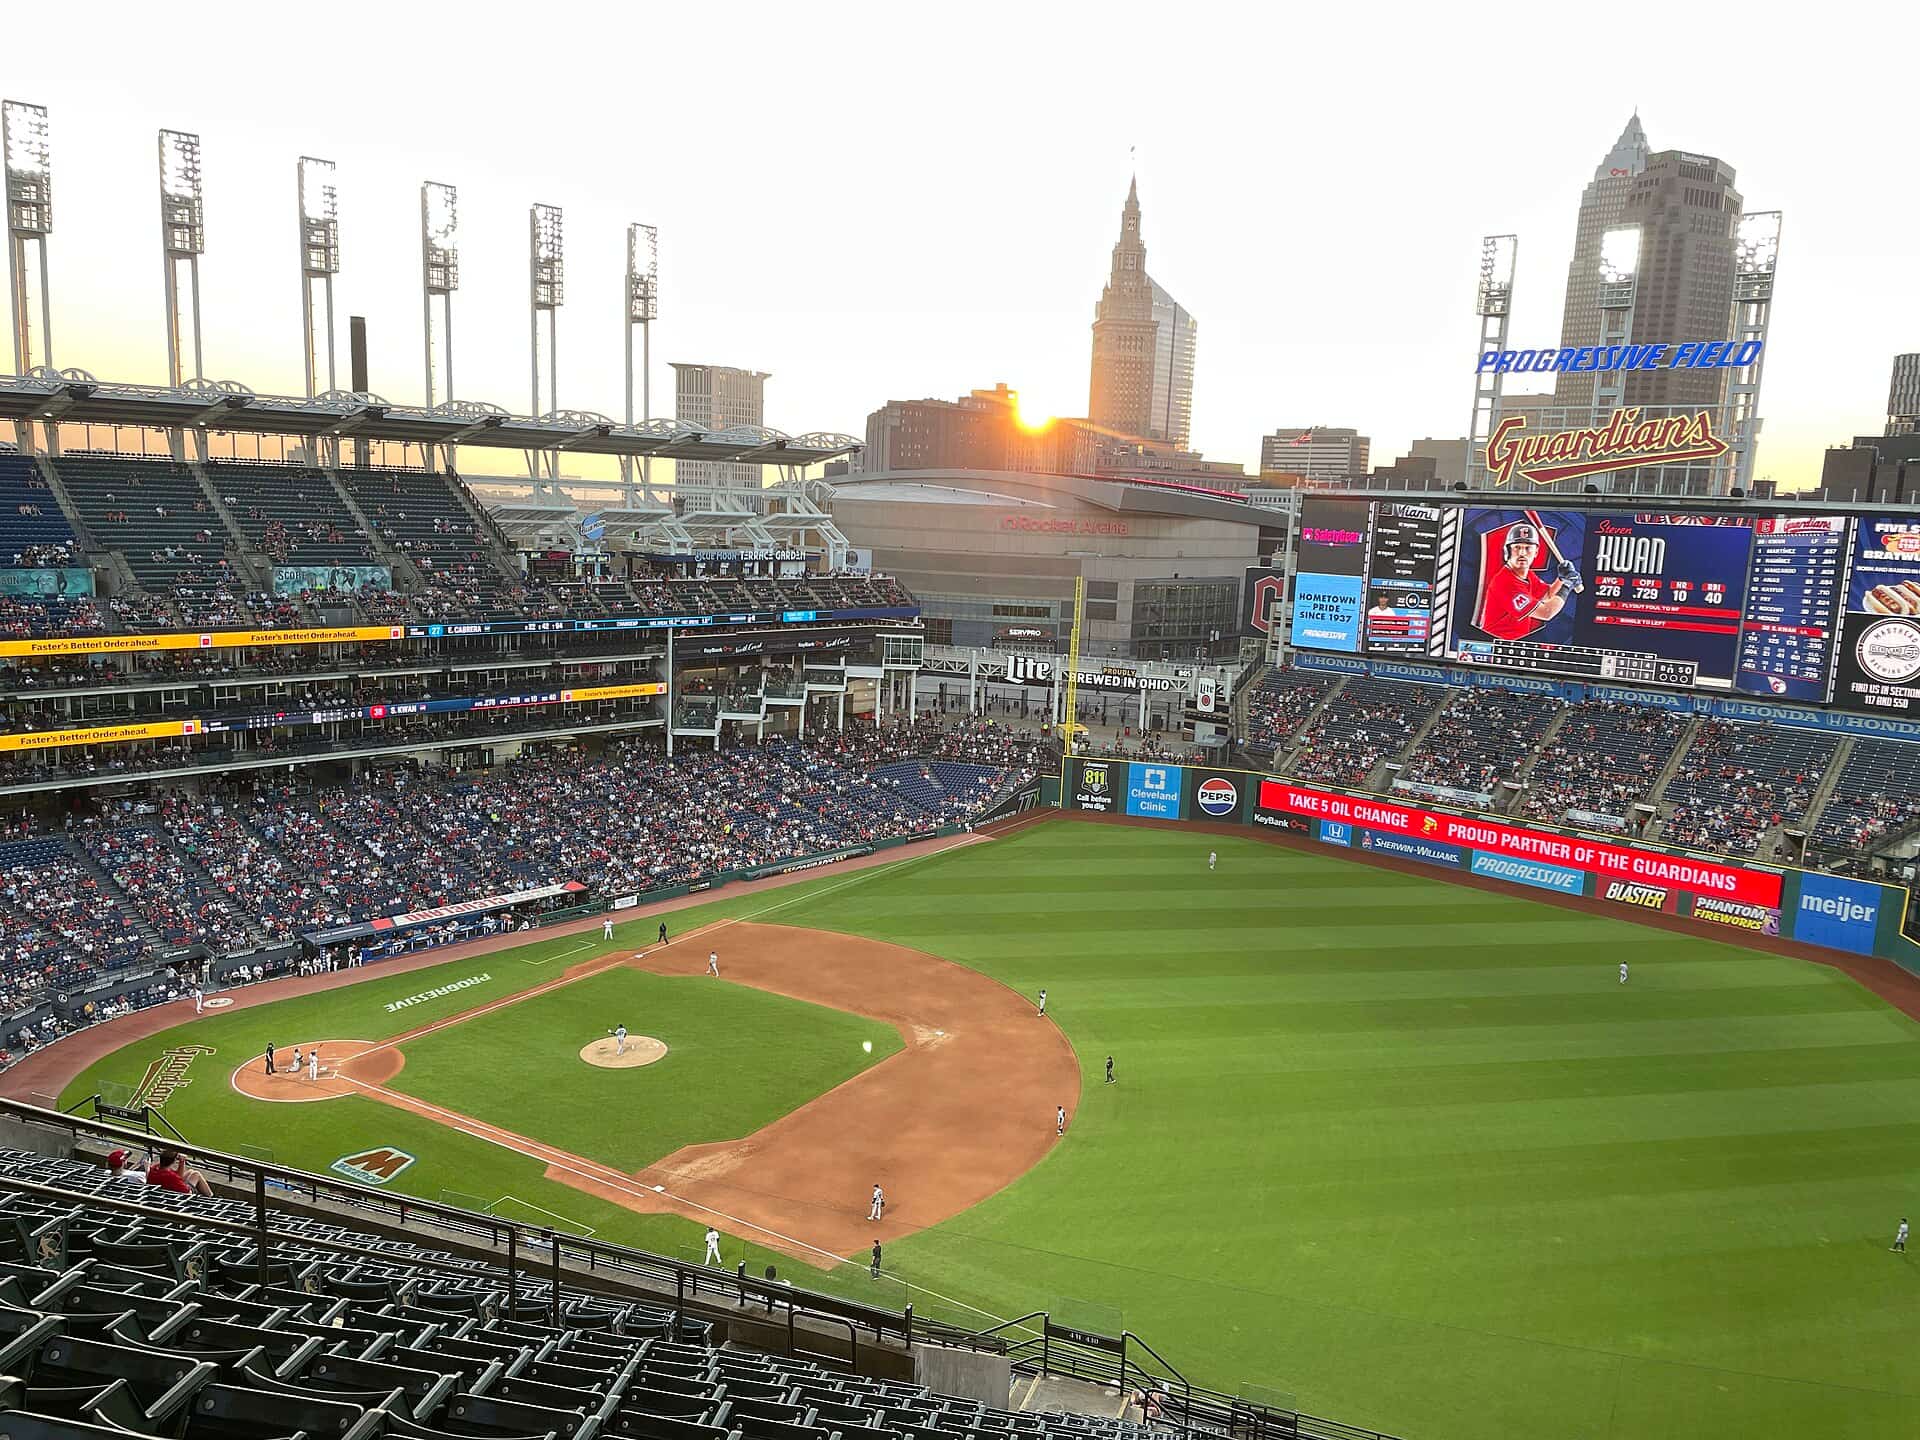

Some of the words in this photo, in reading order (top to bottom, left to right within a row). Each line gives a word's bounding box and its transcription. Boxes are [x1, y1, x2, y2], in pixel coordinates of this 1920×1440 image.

[1476, 345, 1668, 374] PROGRESSIVE
[1670, 341, 1762, 369] FIELD
[1486, 407, 1729, 486] Guardians
[1020, 516, 1076, 533] Rocket
[1082, 519, 1128, 536] Arena
[1595, 520, 1632, 535] Steven
[1784, 517, 1832, 534] Guardians
[716, 551, 736, 560] MOON
[740, 551, 773, 560] TERRACE
[776, 551, 806, 560] GARDEN
[1596, 536, 1666, 574] KWAN
[1602, 577, 1617, 585] AVG
[1639, 579, 1655, 587] OPS
[1677, 581, 1688, 589] HR
[1706, 583, 1721, 591] RBI
[1299, 592, 1356, 604] HOMETOWN
[1595, 586, 1621, 597] .276
[1632, 588, 1658, 600] .729
[1673, 590, 1687, 602] 10
[1705, 592, 1722, 604] 40
[1251, 575, 1284, 632] C
[1312, 604, 1340, 612] PRIDE
[1300, 611, 1326, 620] SINCE
[1329, 614, 1352, 623] 1937
[251, 634, 282, 642] Faster's
[310, 632, 332, 640] Order
[332, 631, 357, 639] ahead.
[430, 627, 441, 635] 27
[453, 625, 482, 633] CABRERA
[1009, 628, 1041, 637] SERVPRO
[31, 642, 68, 652] Faster's
[70, 641, 101, 650] Better!
[103, 639, 129, 648] Order
[130, 638, 160, 647] ahead.
[1005, 656, 1050, 684] Lite
[1314, 656, 1368, 670] HONDA
[1103, 667, 1136, 677] PROUDLY
[1386, 665, 1444, 679] HONDA
[1123, 675, 1136, 688] IN
[1139, 678, 1170, 691] OHIO
[1490, 676, 1554, 691] HONDA
[1851, 682, 1869, 693] FIND
[1869, 684, 1880, 694] US
[1607, 691, 1680, 706] HONDA
[397, 705, 417, 714] KWAN
[1740, 704, 1819, 723] HONDA
[20, 735, 58, 745] Faster's
[59, 733, 91, 742] Better!
[92, 731, 119, 740] Order
[119, 727, 149, 737] ahead.
[1085, 770, 1105, 785] 811
[1077, 793, 1090, 802] Call
[1091, 795, 1112, 804] before
[1131, 788, 1177, 801] Cleveland
[1201, 791, 1234, 803] PEPSI
[1081, 802, 1093, 810] you
[1094, 803, 1107, 812] dig.
[1140, 801, 1167, 813] Clinic
[1254, 813, 1289, 829] KeyBank
[1289, 793, 1318, 811] TAKE
[1321, 801, 1328, 813] 5
[1331, 802, 1351, 817] OIL
[1354, 806, 1408, 829] CHANGE
[1448, 823, 1497, 845] PROUD
[1501, 833, 1570, 860] PARTNER
[1574, 847, 1595, 864] OF
[1598, 851, 1629, 871] THE
[1633, 858, 1737, 892] GUARDIANS
[1322, 835, 1349, 845] HONDA
[1474, 857, 1576, 888] PROGRESSIVE
[1605, 882, 1666, 910] BLASTER
[404, 897, 508, 922] CLEVELAND
[1696, 897, 1766, 920] PHANTOM
[1801, 894, 1875, 922] meijer
[1694, 908, 1763, 931] FIREWORKS
[384, 973, 492, 1013] PROGRESSIVE
